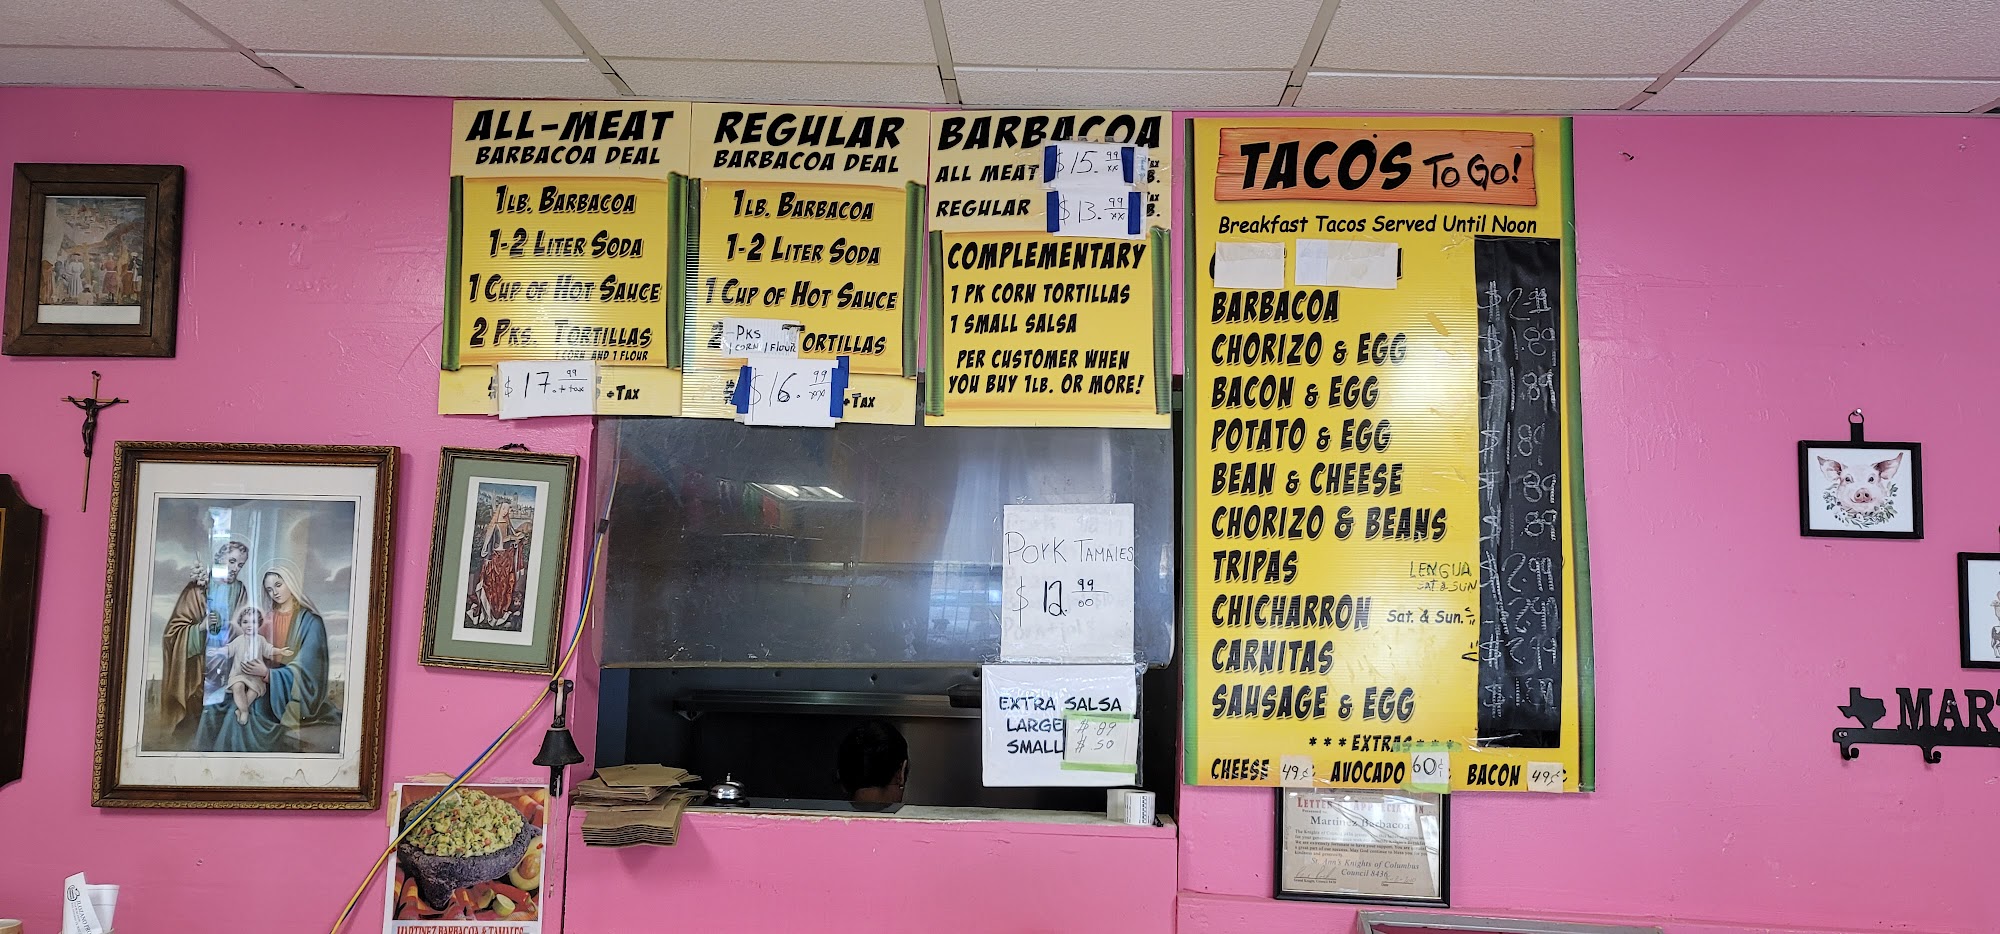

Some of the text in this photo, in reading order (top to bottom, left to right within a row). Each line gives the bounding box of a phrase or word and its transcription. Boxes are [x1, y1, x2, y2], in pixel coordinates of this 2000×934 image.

[465, 109, 674, 142] ALL-MEAT
[713, 111, 905, 150] REGULAR
[937, 114, 1162, 150] BARBACOA
[475, 145, 661, 165] BARBACOA DEAL
[713, 150, 899, 173] BARBACOA DEAL
[1105, 150, 1119, 160] 99
[1239, 138, 1523, 191] TACOS To Go!
[935, 164, 1040, 183] ALL MEAT
[495, 185, 636, 214] 1LB. BARBACOA
[733, 189, 875, 220] 1LB. BARBACOA
[935, 199, 1031, 218] REGULAR
[1108, 197, 1124, 209] 99
[1218, 214, 1538, 234] Breakfast Tacos Served Until Noon
[489, 228, 644, 258] 1-2 LITER SODA
[726, 232, 881, 266] 1-2 LITER SODA
[947, 241, 1146, 270] COMPLEMENTARY
[468, 273, 662, 302] 1 CUP OF HOT SAUCE
[705, 277, 898, 310] 1 CUP OF HOT SAUCE
[951, 283, 1131, 305] 1 PK CORN TORTILLAS
[1210, 290, 1340, 324] BARBACOA
[469, 317, 653, 348] 2 PKS. TORTILLAS
[950, 313, 1078, 334] 1 SMALL SALSA
[591, 350, 609, 361] AND
[612, 350, 618, 361] 1
[619, 350, 649, 361] FLOUR
[735, 343, 759, 352] CORN
[956, 348, 1130, 370] PER CUSTOMER WHEN
[1210, 331, 1408, 367] CHORIZO & EGG
[566, 368, 577, 377] 99
[813, 370, 828, 383] 99
[948, 374, 1145, 395] YOU BUY 1LB. OR MORE!
[568, 385, 585, 393] tax
[1210, 375, 1380, 409] BACON & EGG
[1210, 418, 1393, 453] POTATO & EGG
[1210, 462, 1404, 496] BEAN & CHEESE
[1210, 505, 1448, 542] CHORIZO & BEANS
[1213, 549, 1299, 584] TRIPAS
[1409, 561, 1472, 579] LENGUA
[1210, 594, 1464, 631] CHICHARRON Sat. & Sun.
[1210, 638, 1335, 675] CARNITAS
[999, 696, 1122, 712] EXTRA SALSA
[1211, 683, 1415, 722] SAUSAGE & EGG
[1896, 688, 2000, 733] MAR
[1006, 719, 1064, 733] LARGE
[1006, 739, 1065, 754] SMALL
[1351, 734, 1413, 753] EXTRAS
[1211, 758, 1270, 781] CHEESE
[1330, 760, 1406, 785] AVOCADO
[1466, 763, 1522, 787] BACON
[1341, 868, 1370, 878] Council
[1370, 869, 1389, 879] 8436
[1344, 859, 1372, 870] Knights
[1374, 860, 1383, 870] of
[1384, 860, 1420, 870] Columbus
